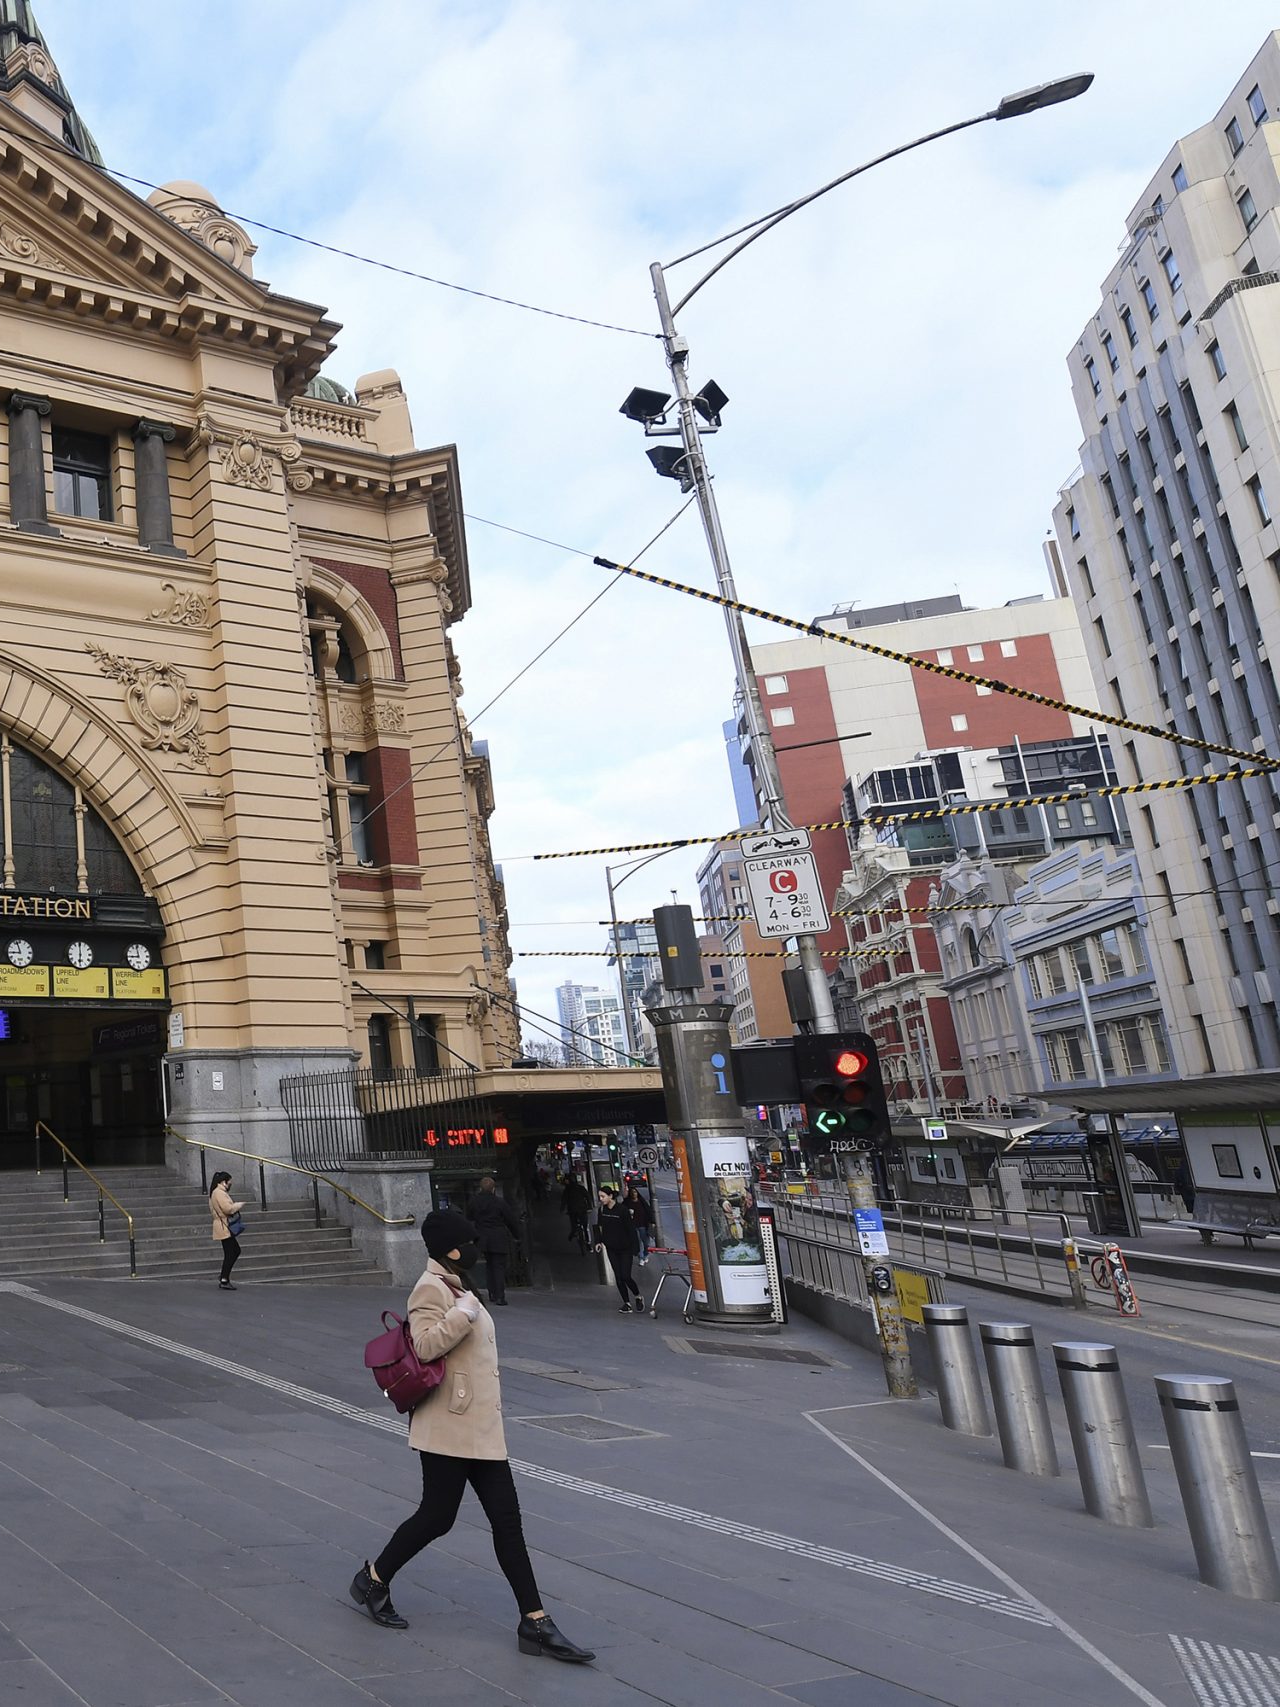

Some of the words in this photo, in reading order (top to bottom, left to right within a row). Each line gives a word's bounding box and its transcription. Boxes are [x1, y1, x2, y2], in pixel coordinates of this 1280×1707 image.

[749, 856, 808, 872] CLEARWAY
[775, 871, 792, 893] C
[767, 924, 790, 933] MON
[802, 920, 820, 929] FRI
[448, 1129, 484, 1146] CITY
[641, 1151, 656, 1161] 40
[714, 1163, 732, 1171] ACT
